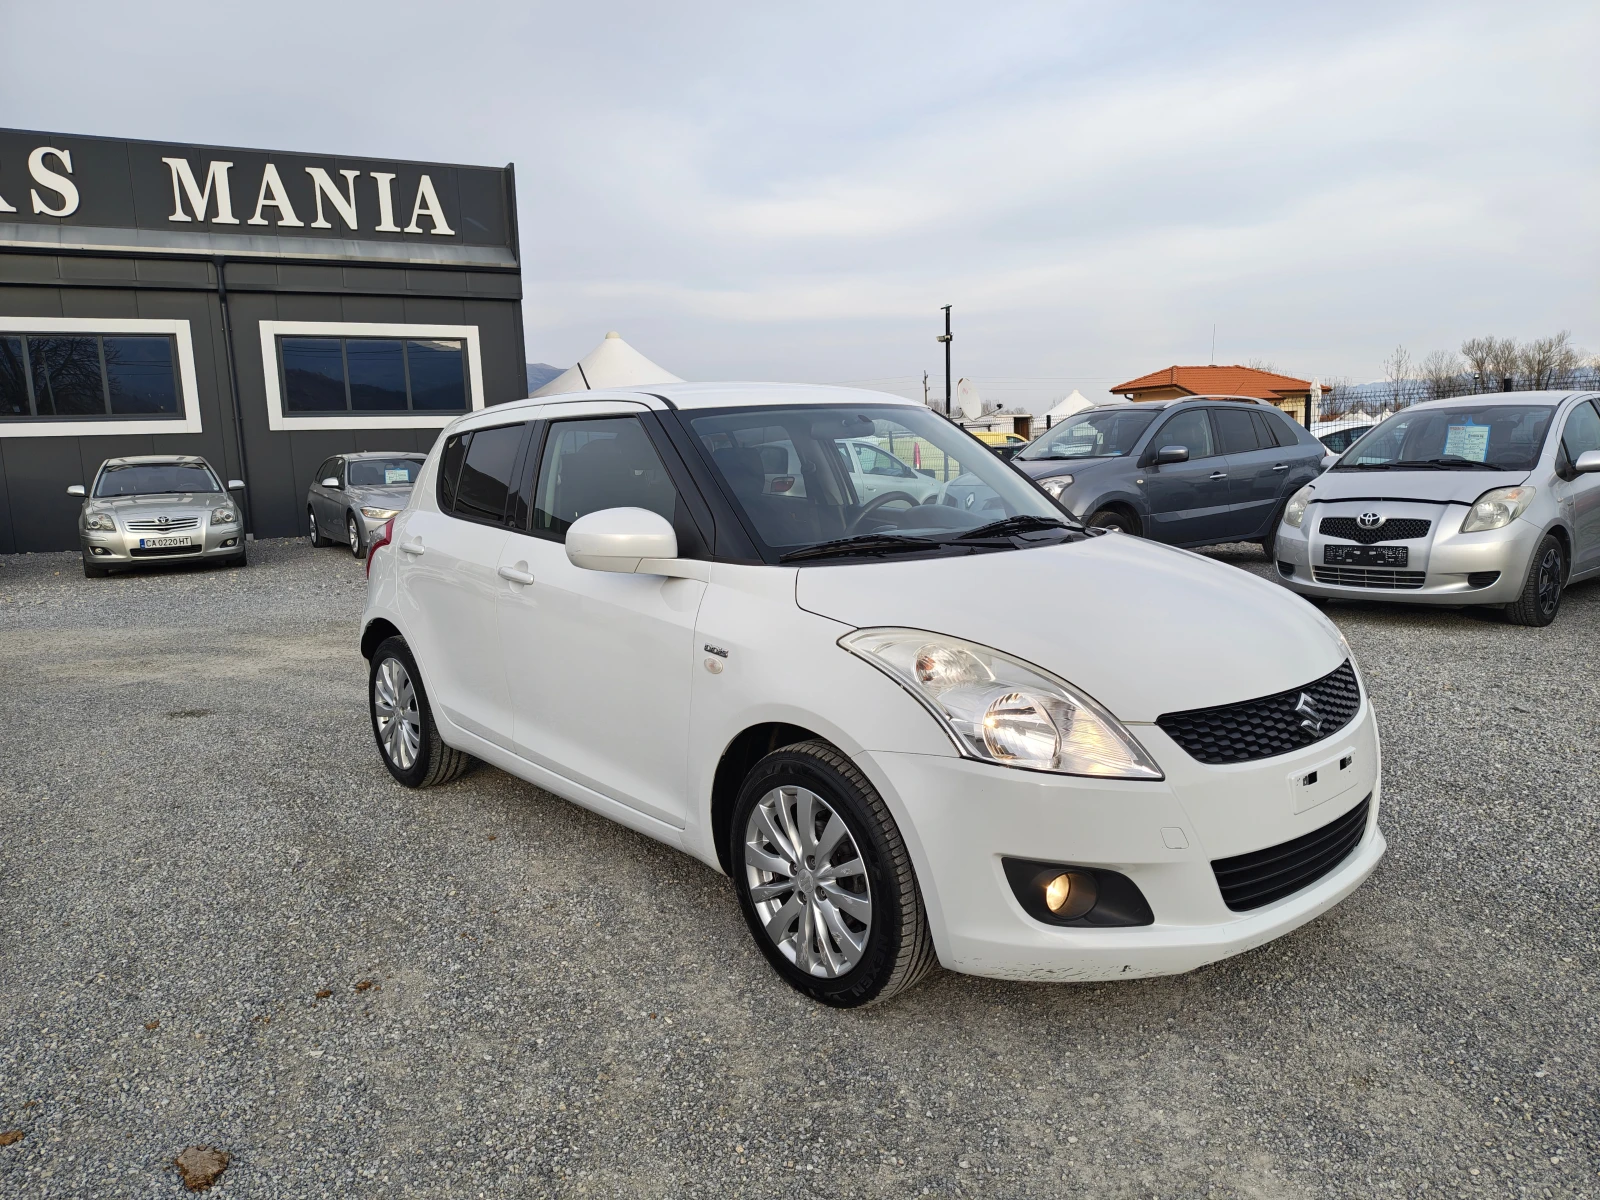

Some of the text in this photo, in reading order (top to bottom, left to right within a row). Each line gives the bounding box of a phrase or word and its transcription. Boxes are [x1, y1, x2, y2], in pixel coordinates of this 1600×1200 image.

[0, 146, 456, 236] S MANIA
[146, 537, 189, 548] CA 0220 HT
[852, 935, 888, 997] NEXEN
